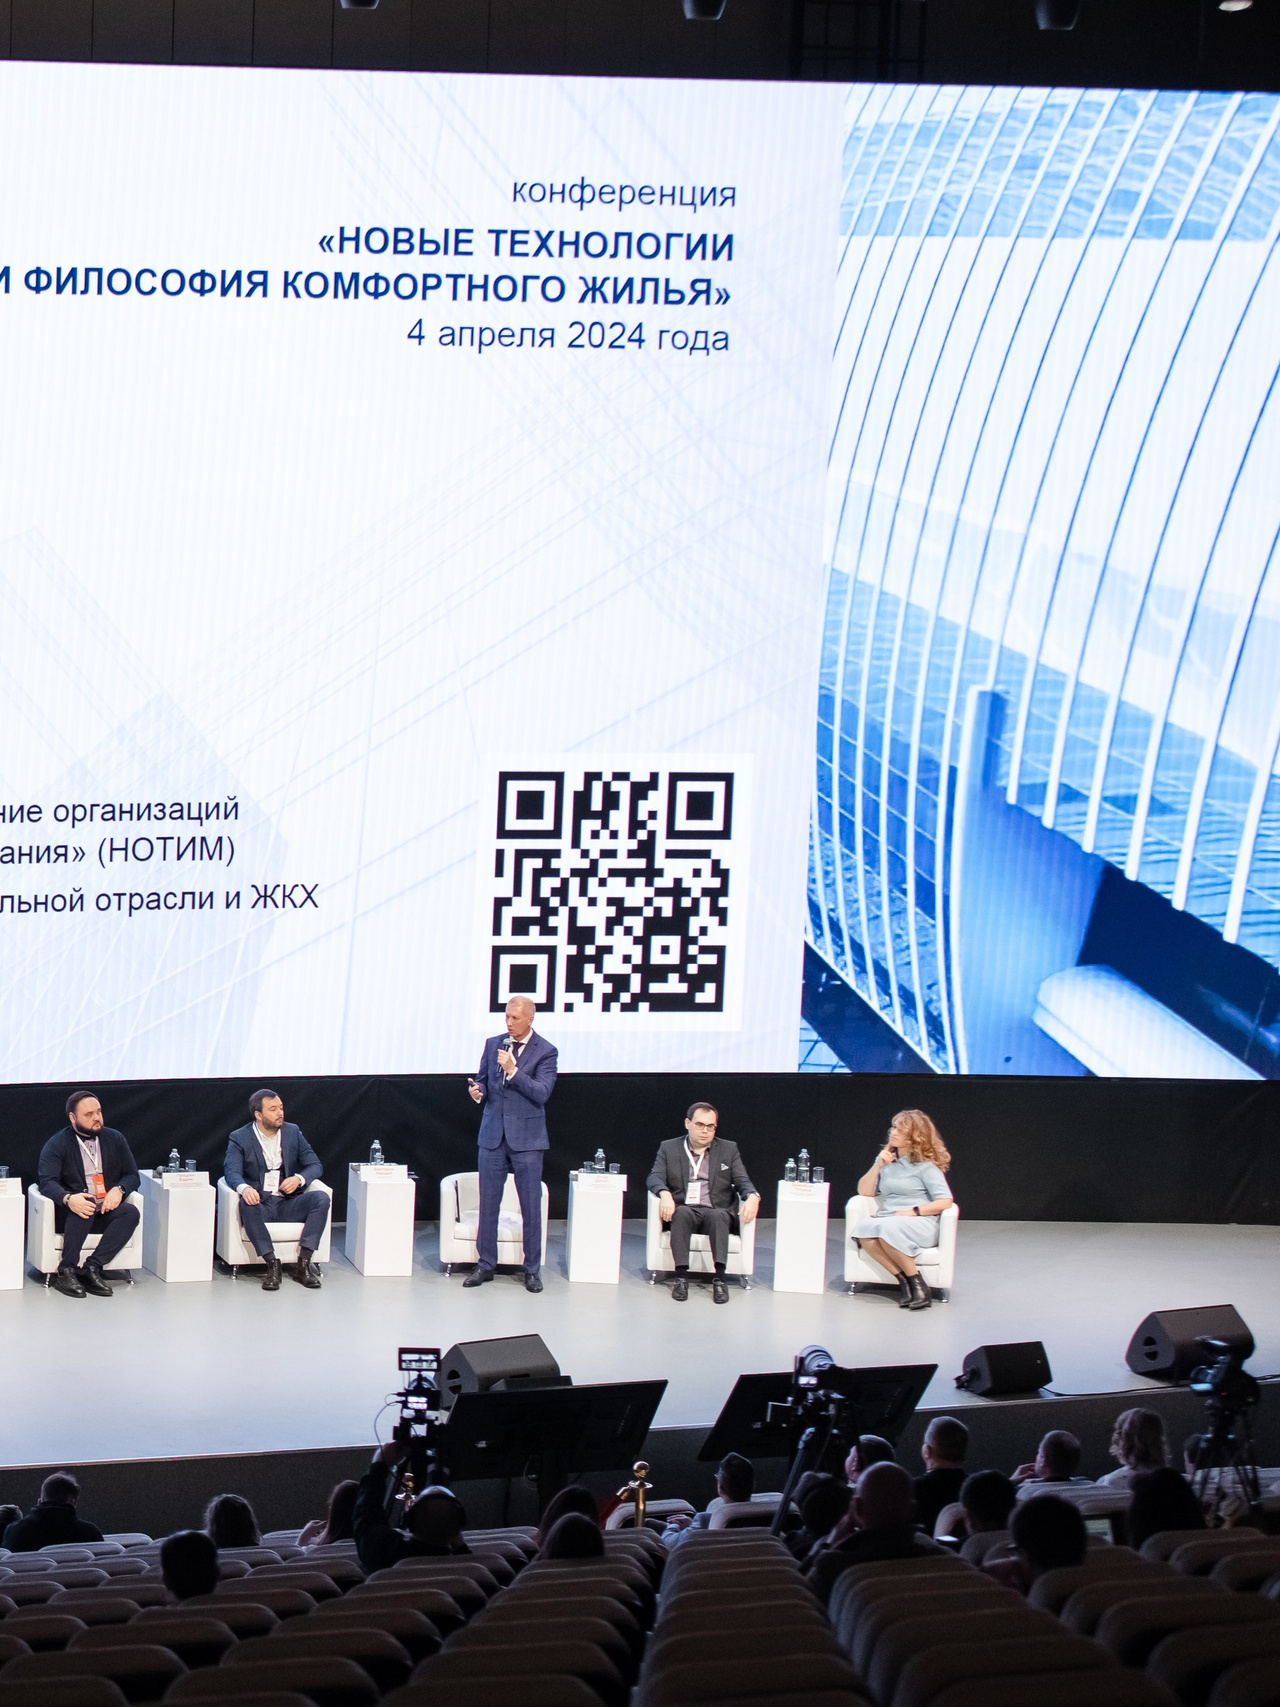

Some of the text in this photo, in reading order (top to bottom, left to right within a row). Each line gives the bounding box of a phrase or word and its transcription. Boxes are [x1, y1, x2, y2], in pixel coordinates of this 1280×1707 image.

[513, 175, 737, 214] конференция
[318, 225, 735, 262] «НОВЫЕ ТЕХНОЛОГИИ
[23, 266, 269, 298] ФИЛОСОФИЯ
[282, 270, 567, 303] КОМФОРТНОГО
[578, 275, 732, 306] ЖИЛЬЯ»
[407, 317, 730, 357] 4 апреля 2024 года
[53, 795, 239, 829] организаций
[98, 835, 235, 869] (НОТИМ)
[95, 890, 215, 918] отрасли
[225, 890, 241, 910] и
[250, 883, 320, 909] ЖКХ
